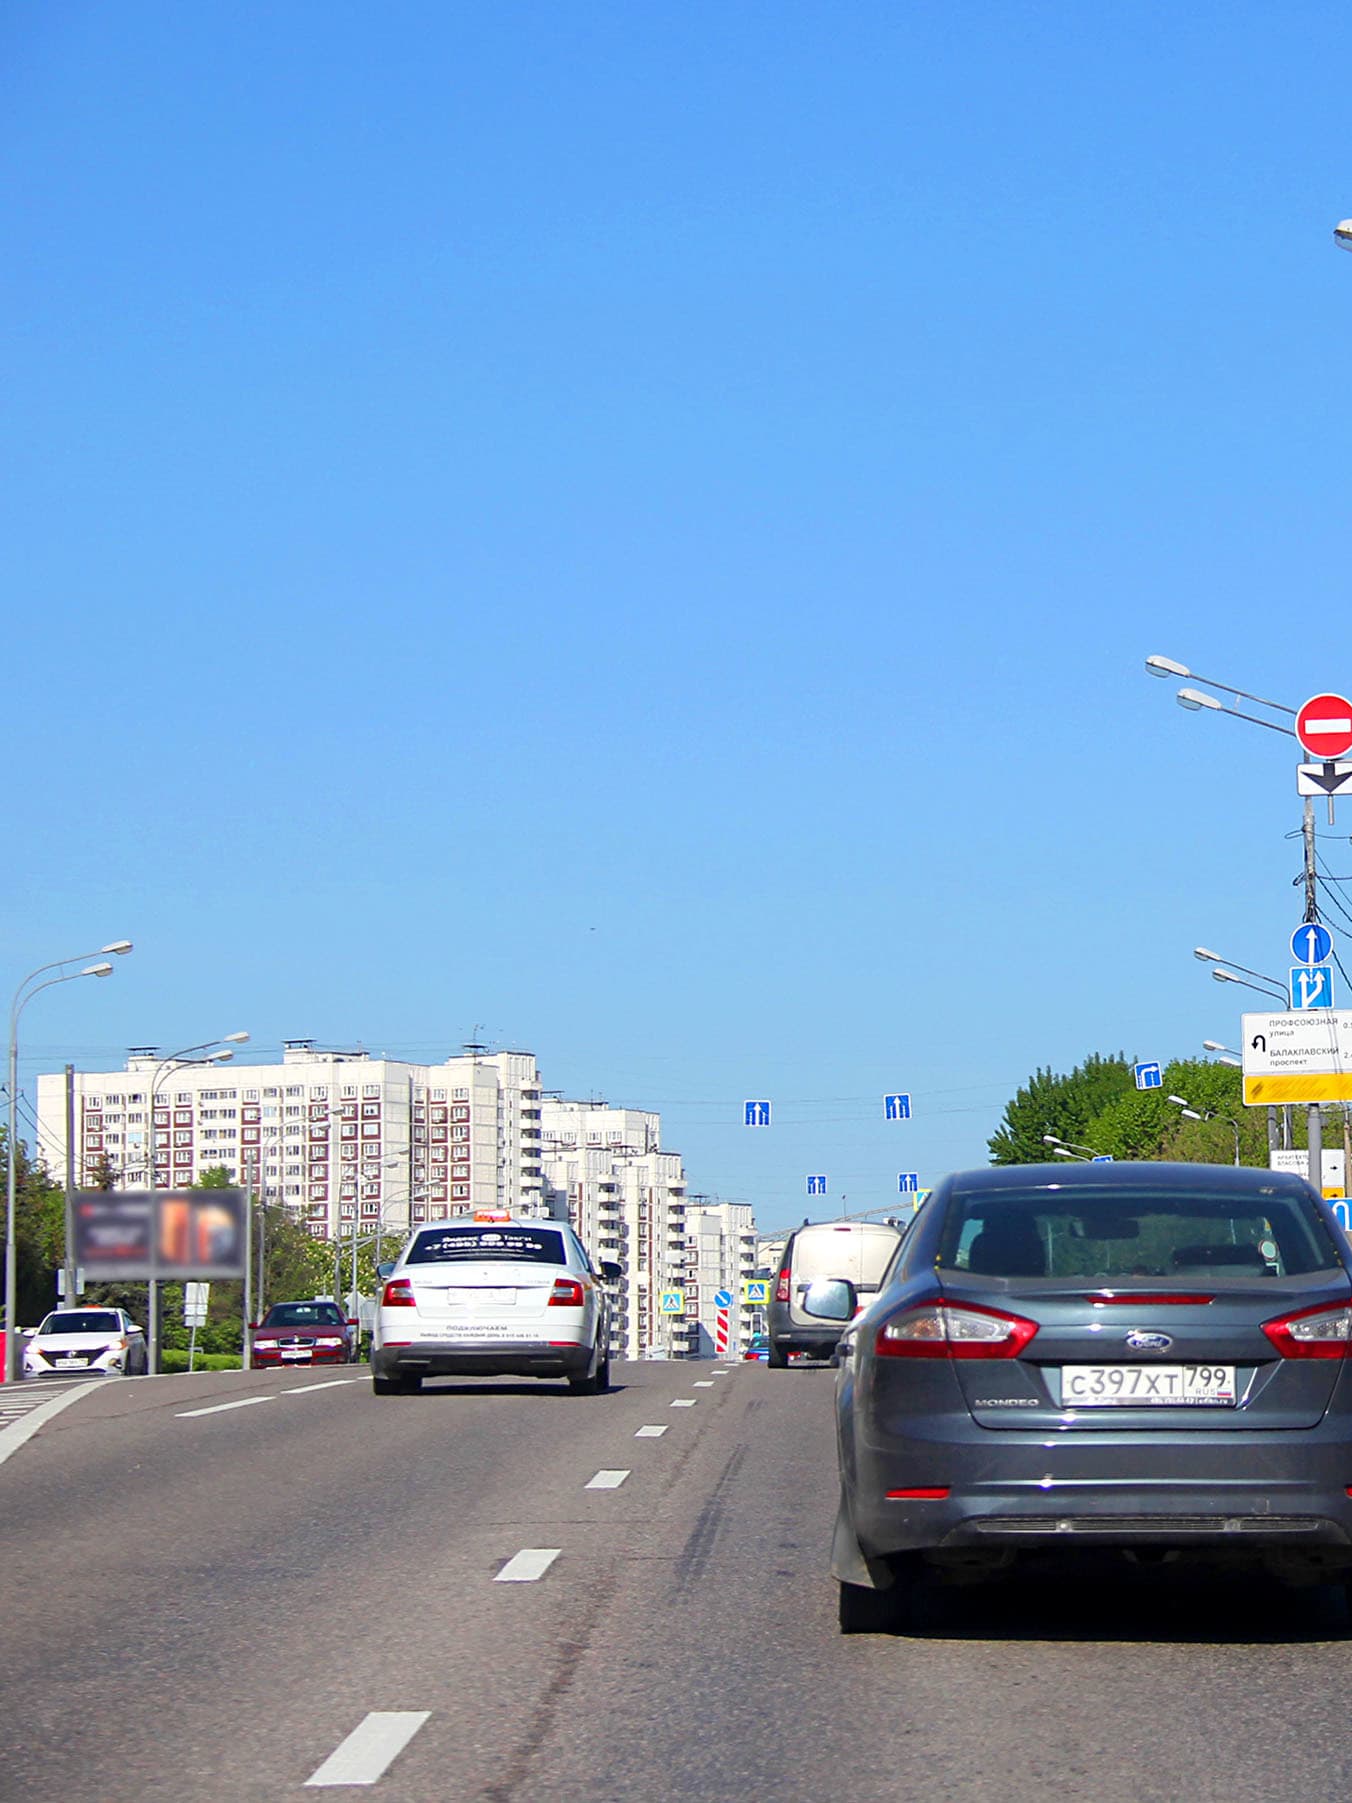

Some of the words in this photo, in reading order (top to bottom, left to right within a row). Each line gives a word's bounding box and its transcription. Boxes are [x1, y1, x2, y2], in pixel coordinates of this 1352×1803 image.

[1269, 1017, 1339, 1028] ПРОФСОЮЗНАЯ
[1269, 1030, 1295, 1038] улица
[1269, 1046, 1339, 1058] БАЛАКЛАВСКИЙ
[1269, 1059, 1308, 1067] проспект
[1135, 1333, 1163, 1349] Ford
[1069, 1368, 1179, 1396] С397ХТ
[1186, 1366, 1226, 1387] 799
[1195, 1388, 1216, 1396] RUS
[974, 1397, 1039, 1407] MONDEO
